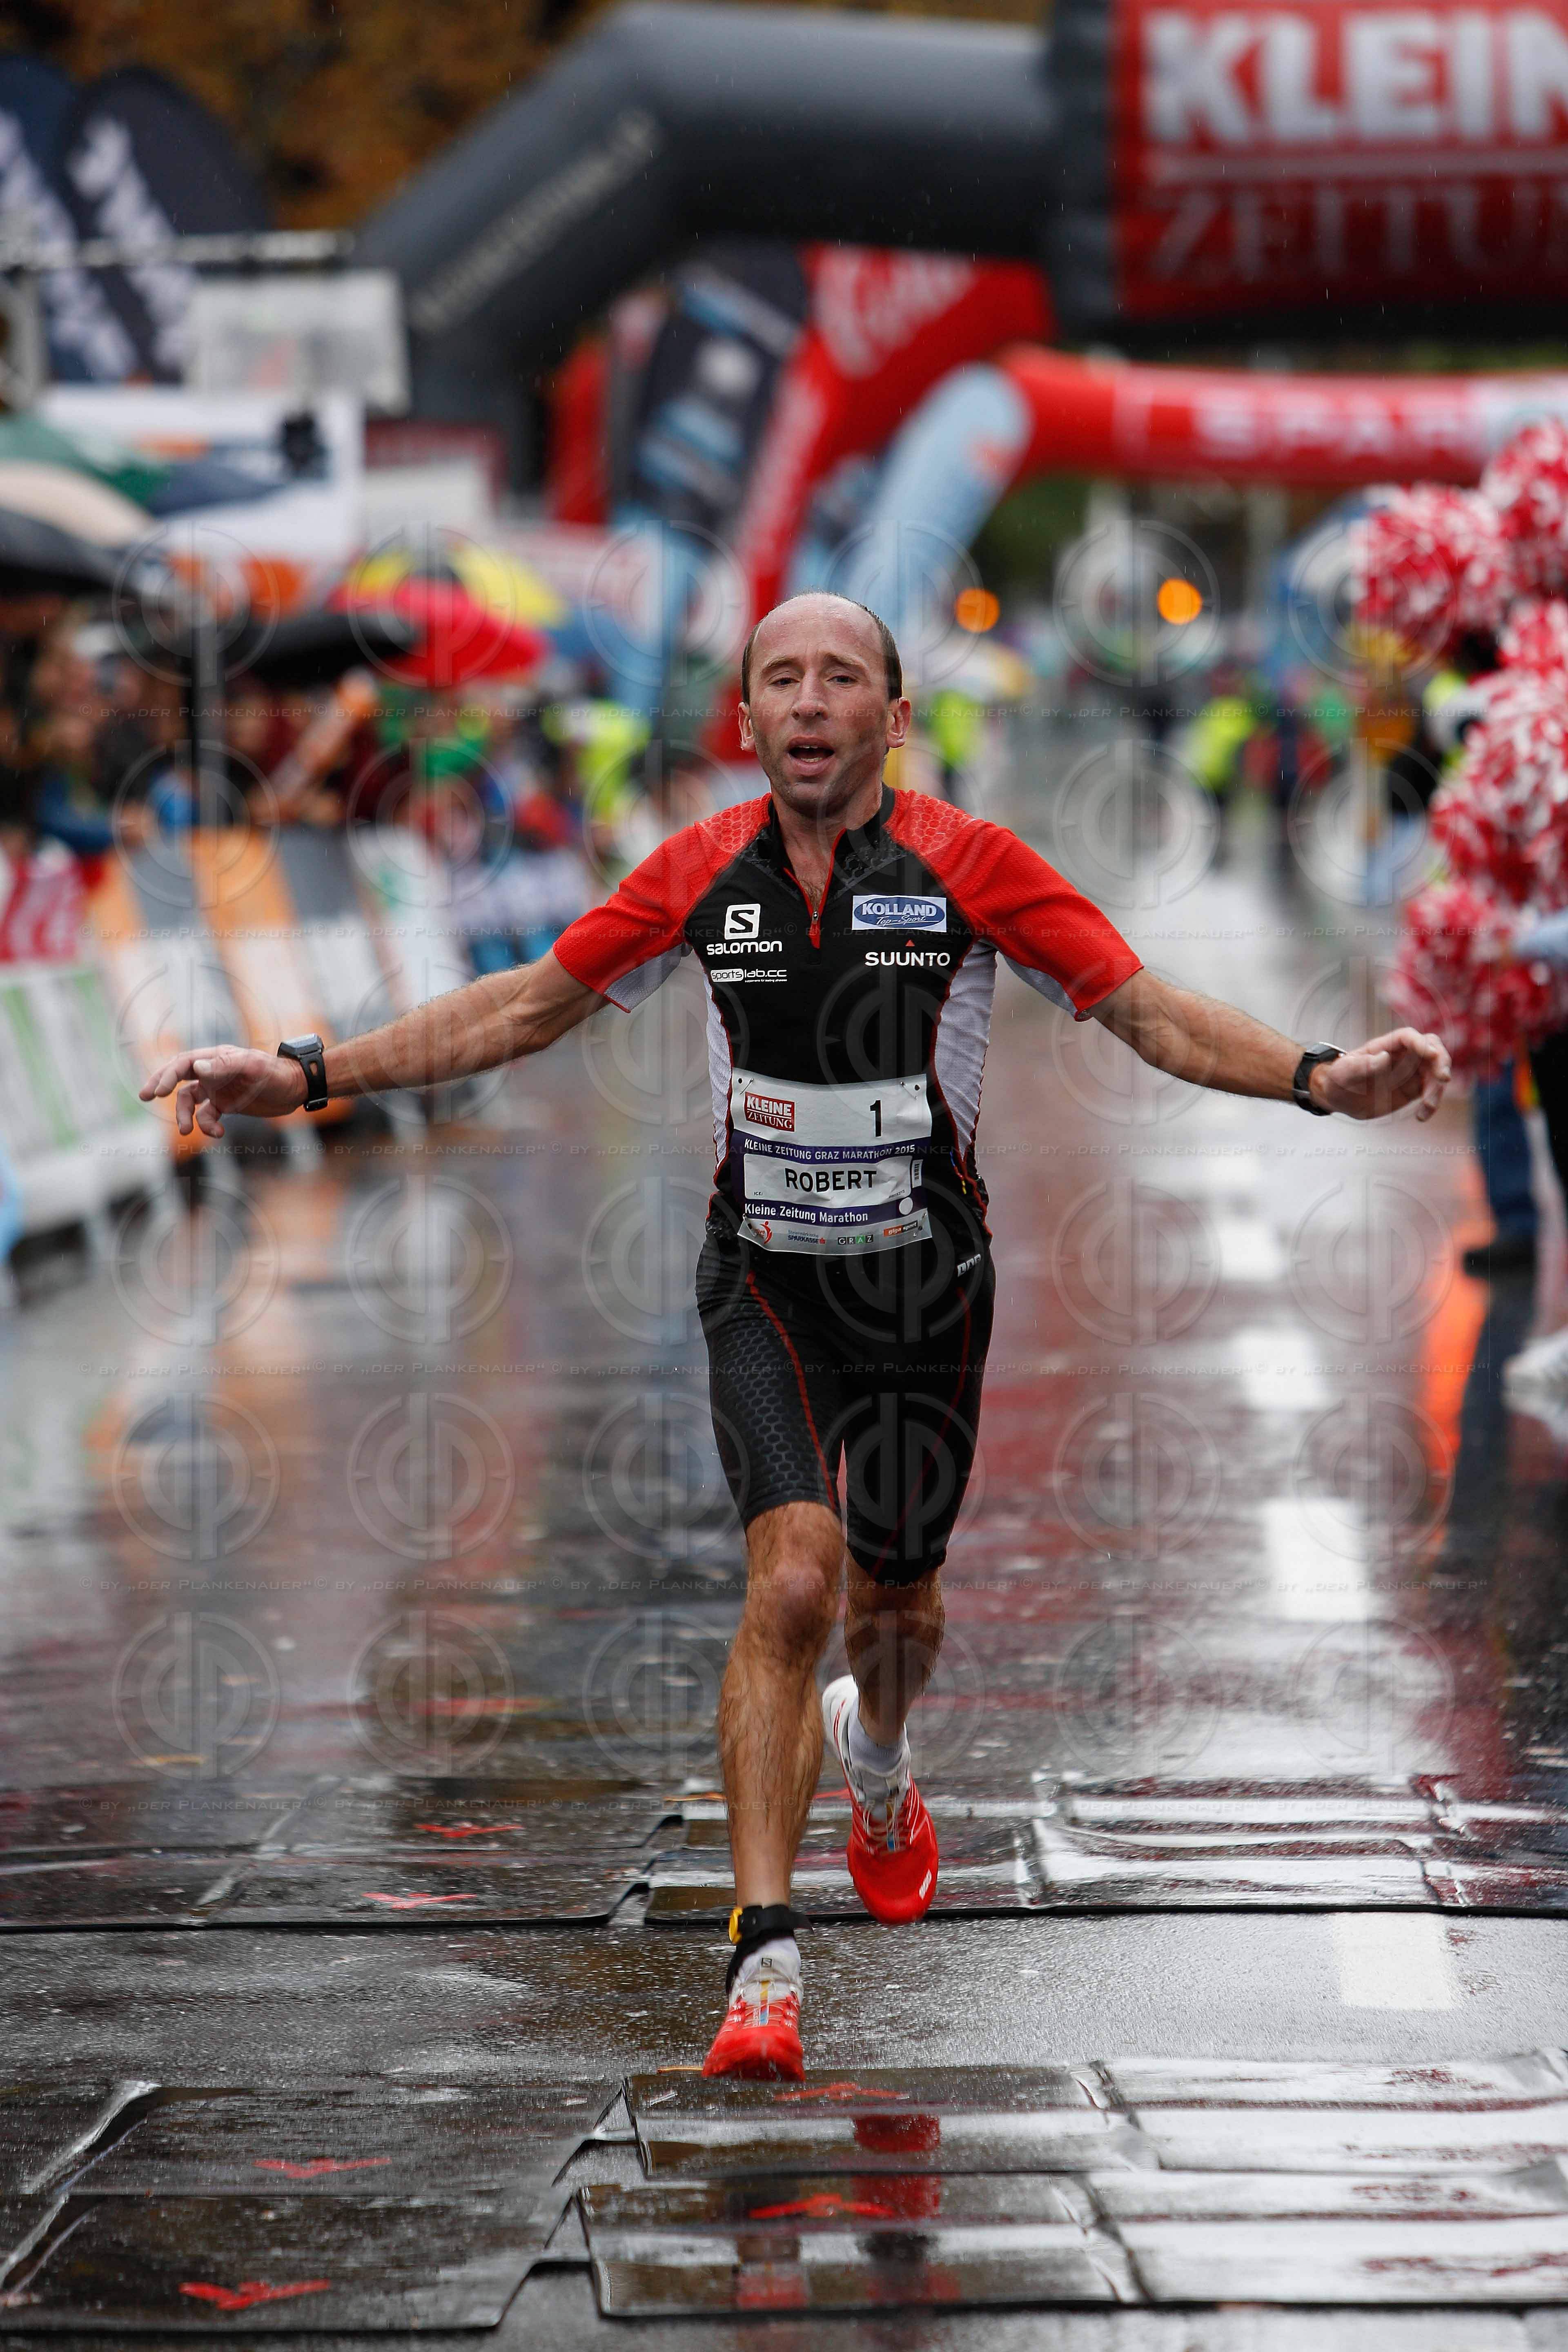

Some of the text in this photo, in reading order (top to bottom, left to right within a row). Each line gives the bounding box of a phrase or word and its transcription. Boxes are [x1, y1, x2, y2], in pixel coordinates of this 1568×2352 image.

[862, 903, 937, 917] KOLLAND
[876, 914, 927, 926] Top-Sport
[865, 952, 950, 966] SUUNTO
[747, 1095, 792, 1116] KLEINE
[747, 1111, 792, 1129] ZEITUNG
[870, 1100, 882, 1137] 1
[744, 1138, 915, 1160] KLEINE ZEITUNG GRAZ MARATHON 2015
[785, 1168, 877, 1192] ROBERT
[745, 1203, 868, 1223] Kleine Zeitung Marathon
[788, 1235, 819, 1244] SPARKASSE
[838, 1235, 873, 1245] GRAZ
